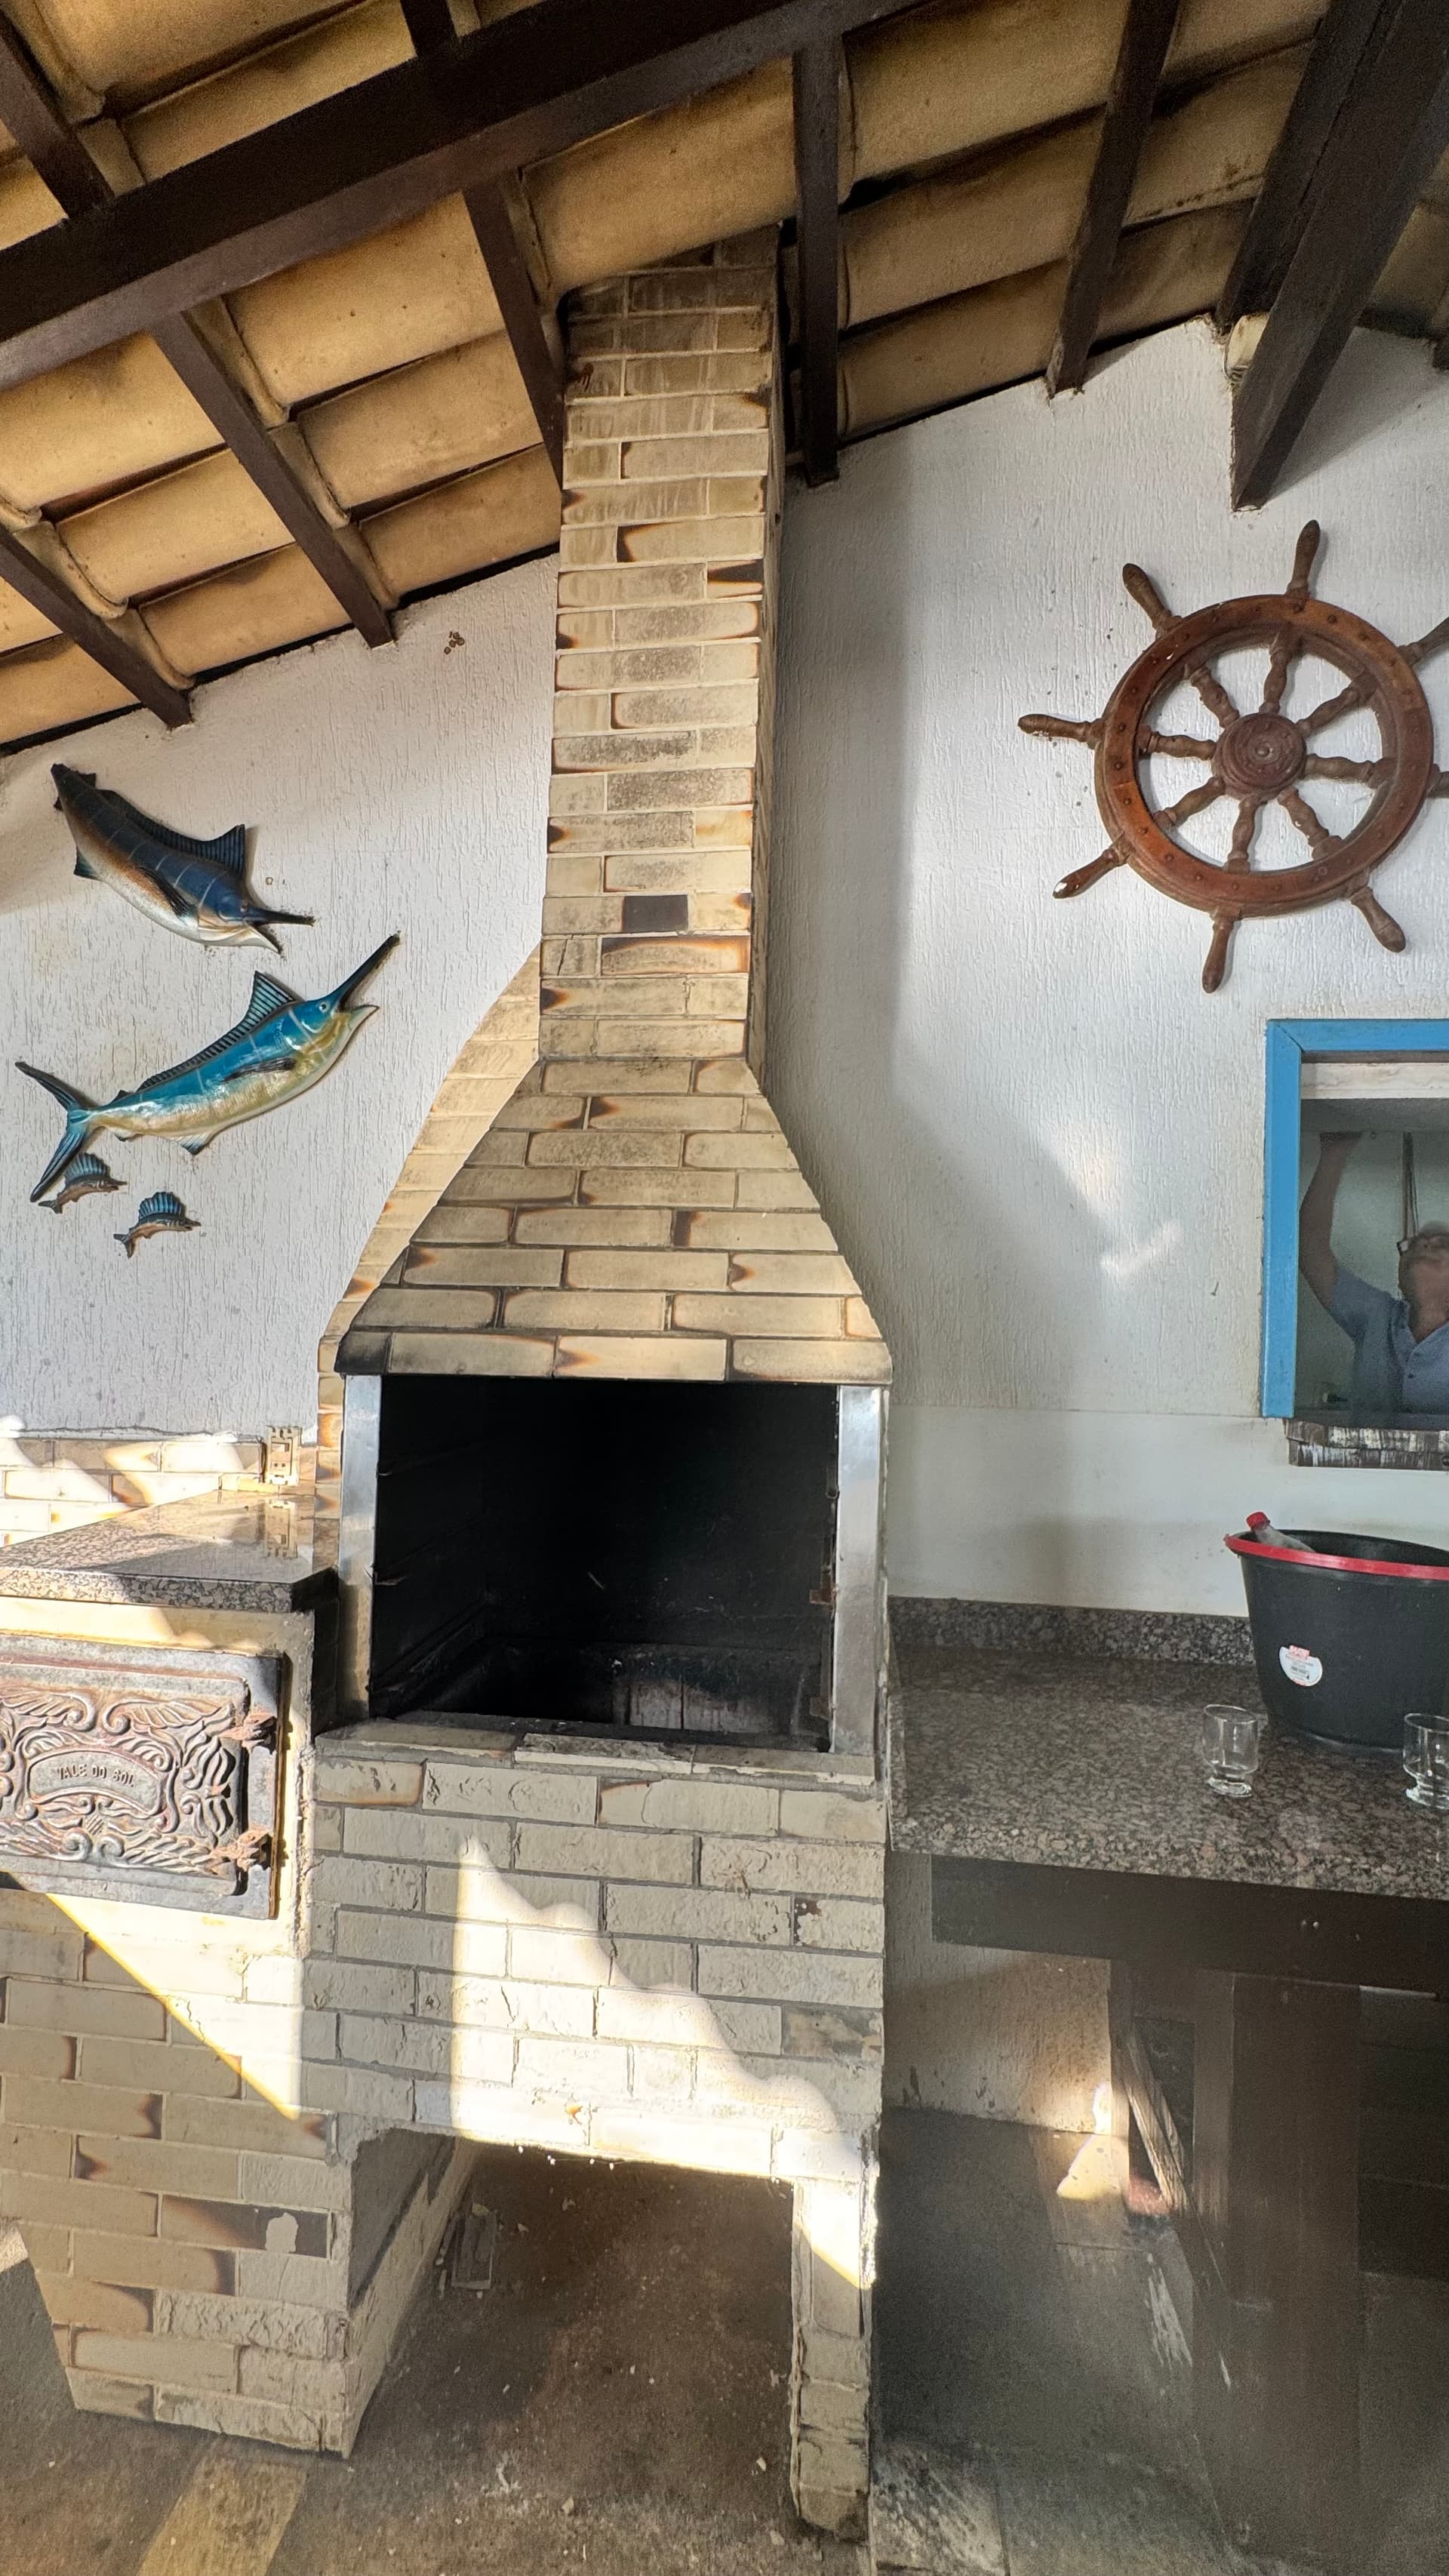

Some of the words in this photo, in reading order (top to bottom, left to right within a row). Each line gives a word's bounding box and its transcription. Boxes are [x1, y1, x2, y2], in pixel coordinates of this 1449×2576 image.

[57, 1764, 88, 1780] VALE
[91, 1765, 108, 1780] DO
[112, 1768, 135, 1788] SOL
